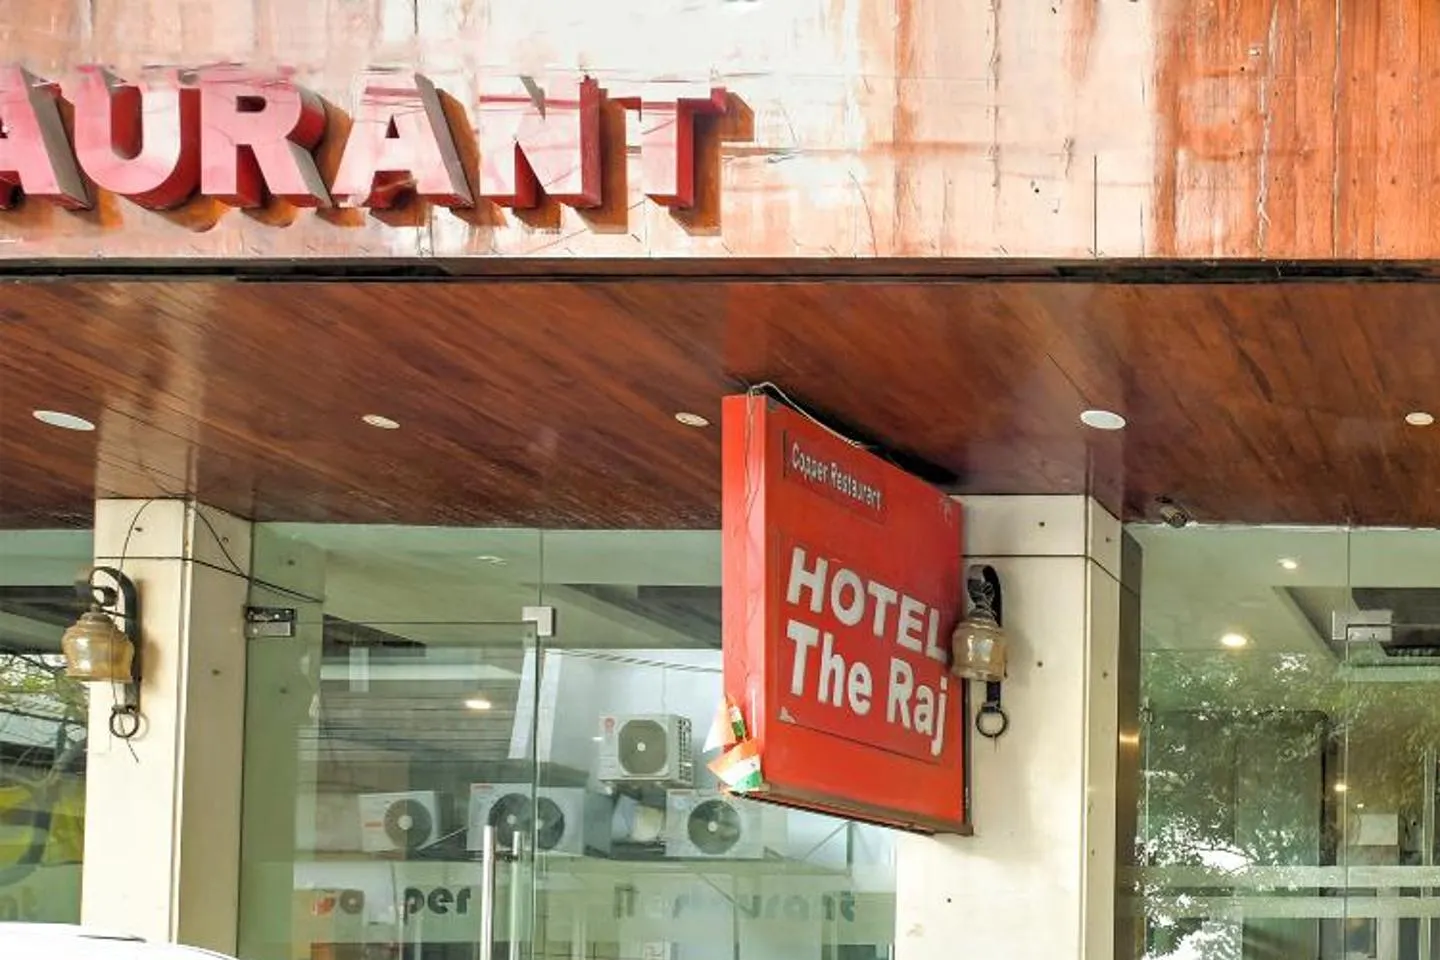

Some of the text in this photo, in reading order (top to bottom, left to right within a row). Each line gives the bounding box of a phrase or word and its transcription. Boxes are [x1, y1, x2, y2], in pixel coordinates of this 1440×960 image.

[792, 441, 881, 511] Copper Restaurant
[786, 546, 948, 661] HOTEL
[786, 619, 948, 756] The Raj
